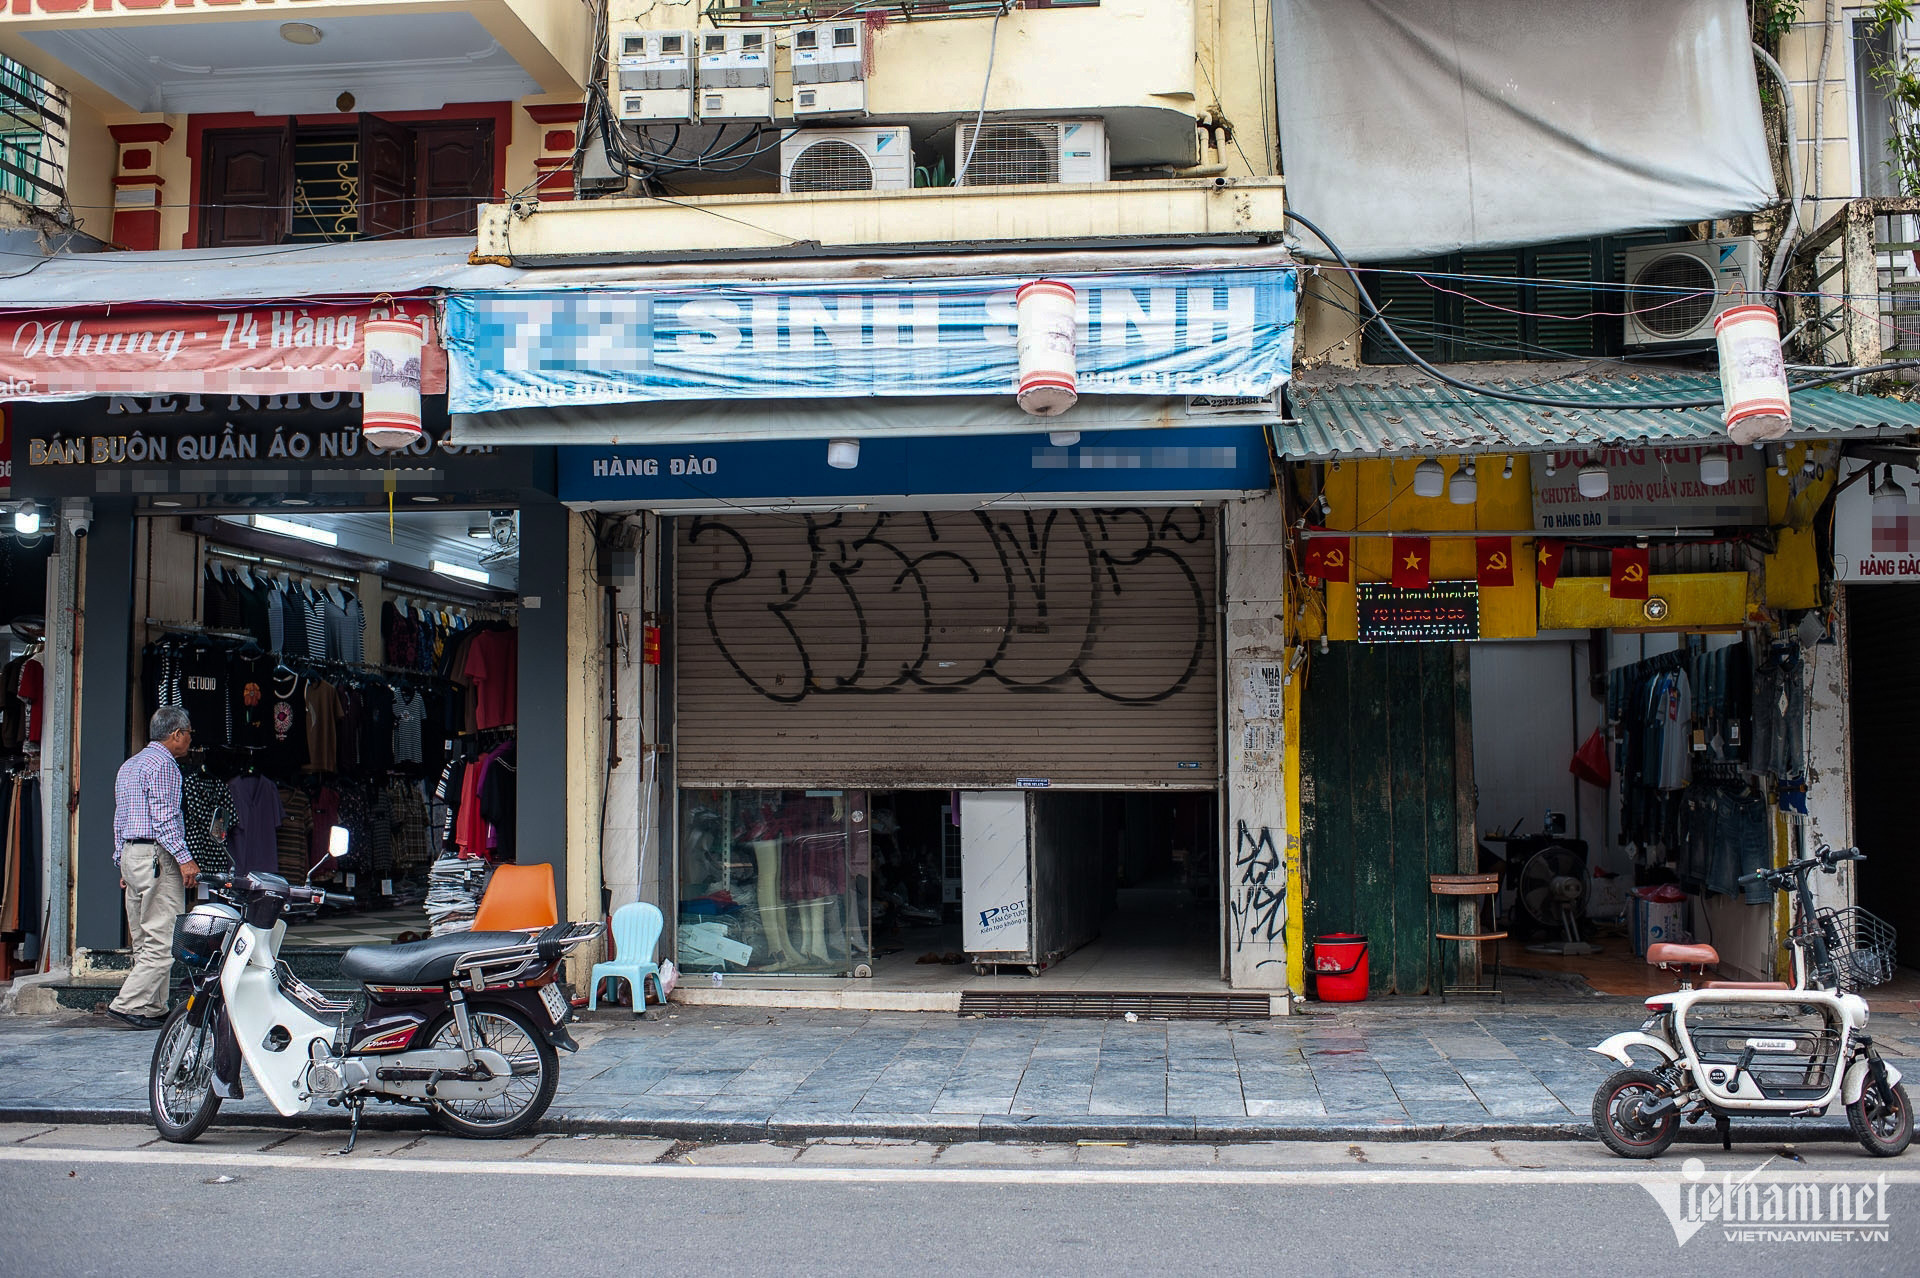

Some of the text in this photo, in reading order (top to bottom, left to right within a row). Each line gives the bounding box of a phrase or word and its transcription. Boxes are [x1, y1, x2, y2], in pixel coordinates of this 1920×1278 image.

[12, 320, 188, 362] Nhung
[217, 312, 259, 351] 74
[271, 308, 357, 350] Hàng
[676, 294, 939, 352] SINH
[30, 432, 85, 466] BÁN
[91, 430, 167, 464] BUÔN
[177, 422, 257, 461] QUẦN
[268, 426, 311, 459] ÁO
[320, 426, 361, 458] NỮ
[593, 454, 717, 477] HÀNG ĐÀO
[1614, 482, 1644, 501] BUÔN
[1646, 475, 1677, 502] QUẦN
[1680, 480, 1709, 498] JEAN
[1739, 474, 1756, 495] NỮ
[1542, 515, 1554, 528] 70
[1556, 512, 1581, 527] HÀNG
[1583, 510, 1602, 526] ĐÀO
[1859, 553, 1895, 576] HÀNG
